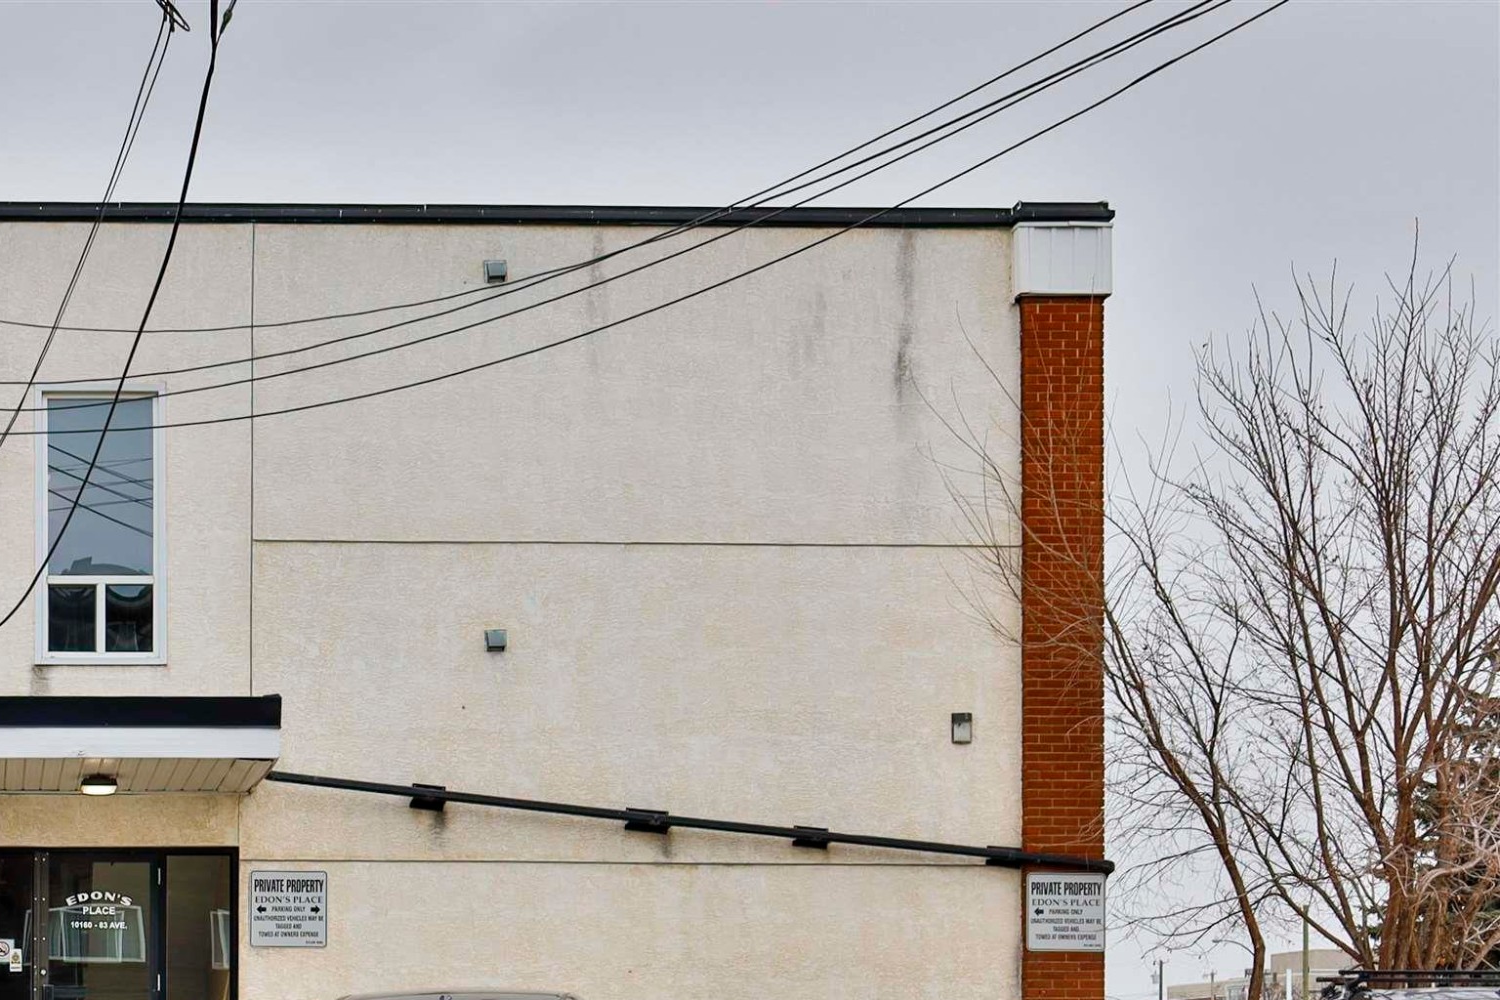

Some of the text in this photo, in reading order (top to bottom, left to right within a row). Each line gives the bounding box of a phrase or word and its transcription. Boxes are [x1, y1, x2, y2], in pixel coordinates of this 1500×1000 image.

[255, 879, 323, 892] PRIVATE PROPERTY
[1031, 882, 1101, 895] PRIVATE PROPERTY
[66, 891, 132, 906] EDON'S
[82, 906, 115, 915] PLACE
